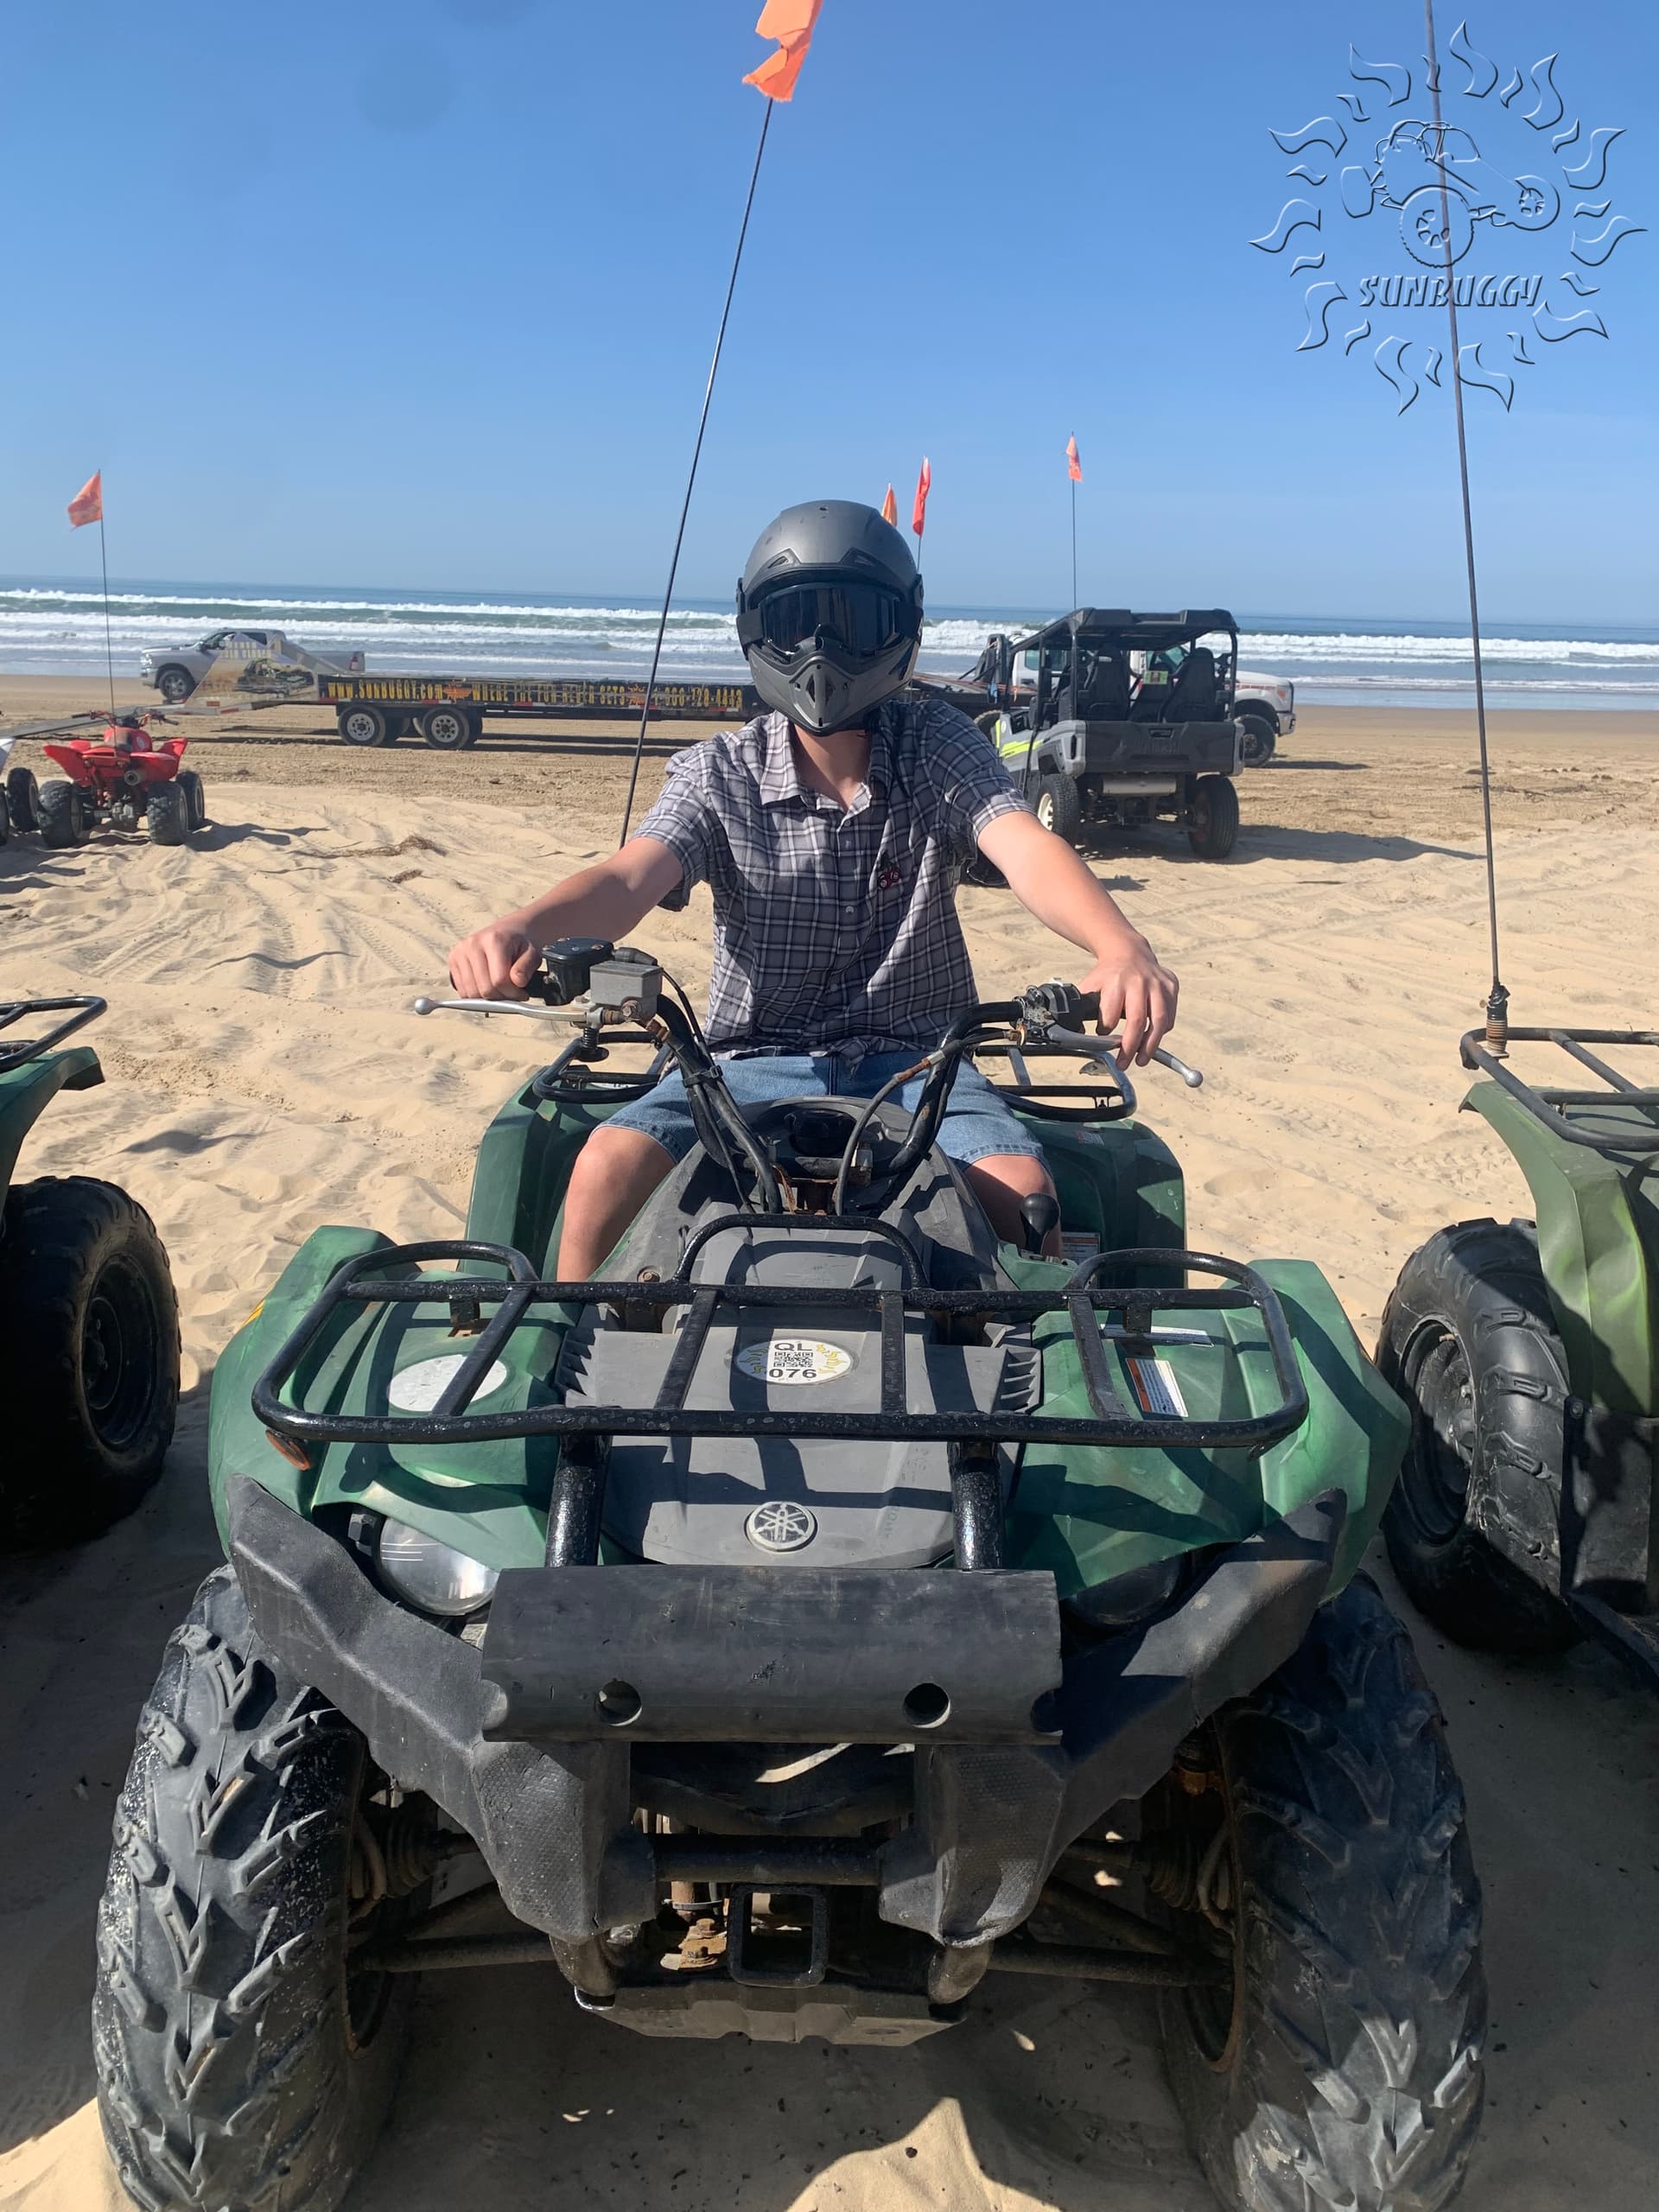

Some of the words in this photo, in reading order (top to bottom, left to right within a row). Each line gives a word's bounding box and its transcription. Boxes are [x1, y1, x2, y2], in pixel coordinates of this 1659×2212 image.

[600, 684, 626, 706] SETS
[774, 1342, 812, 1351] QL
[769, 1369, 817, 1378] 076
